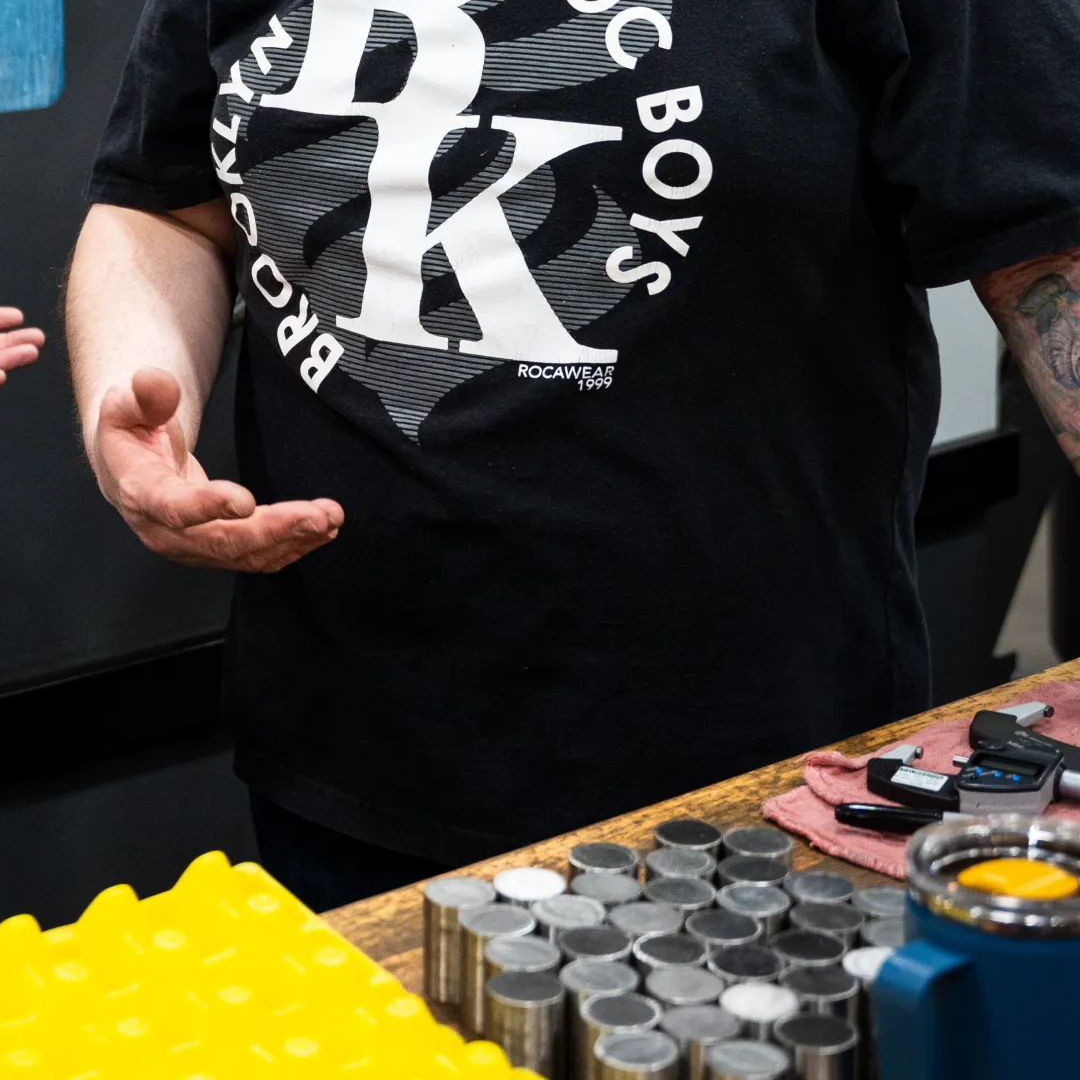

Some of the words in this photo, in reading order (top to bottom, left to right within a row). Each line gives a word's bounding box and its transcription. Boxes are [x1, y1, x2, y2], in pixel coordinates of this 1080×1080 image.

[210, 14, 345, 394] BROOKLYN
[605, 85, 714, 296] BOYS
[517, 363, 615, 380] ROCAWEAR
[577, 376, 613, 391] 1999
